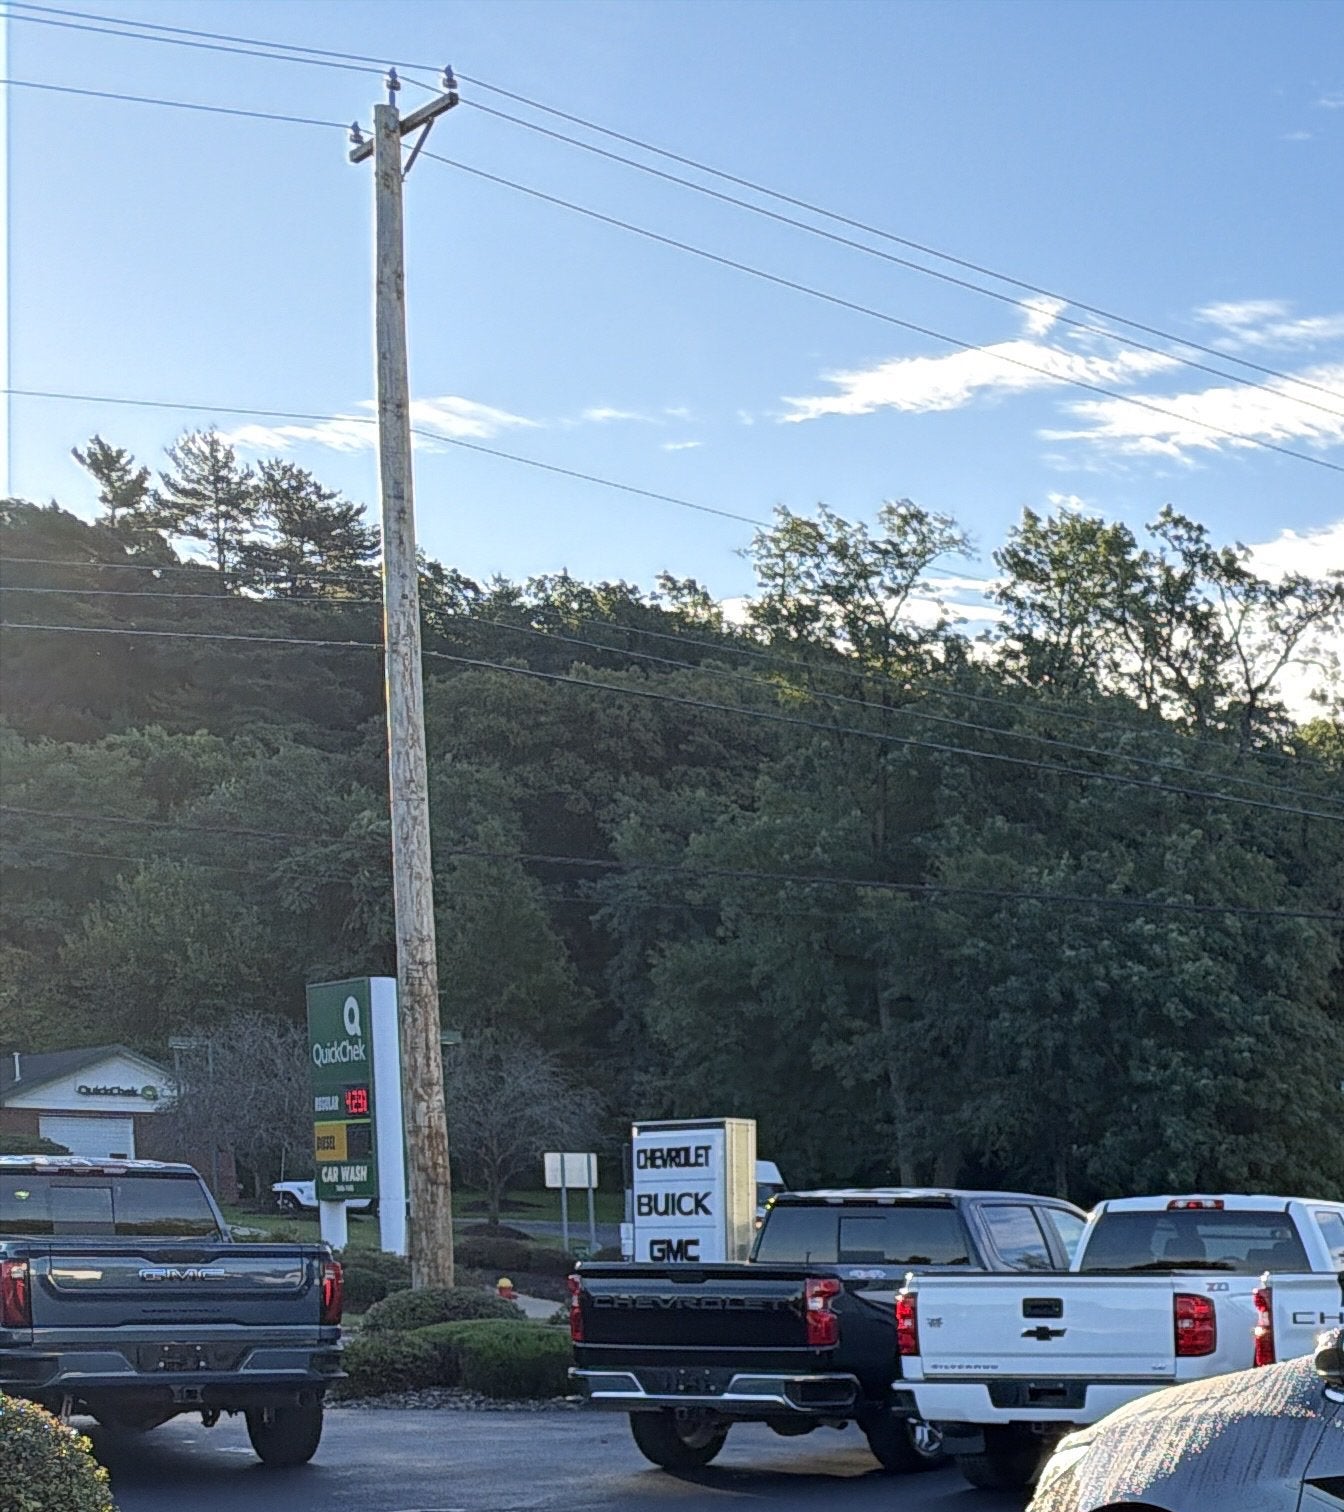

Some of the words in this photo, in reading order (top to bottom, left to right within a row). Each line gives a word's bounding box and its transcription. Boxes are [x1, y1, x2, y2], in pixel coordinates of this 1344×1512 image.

[343, 996, 361, 1036] Q
[313, 1038, 366, 1067] QuickChek
[77, 1085, 138, 1097] QuickChek
[314, 1096, 339, 1112] REGULAR
[317, 1135, 336, 1151] DIESEL
[636, 1145, 712, 1169] CHEVROLET
[321, 1166, 338, 1183] CAR
[341, 1165, 368, 1182] WASH
[637, 1191, 712, 1216] BUICK
[649, 1238, 700, 1262] GMC
[138, 1268, 225, 1281] GMC
[592, 1295, 785, 1310] CHEVROLET
